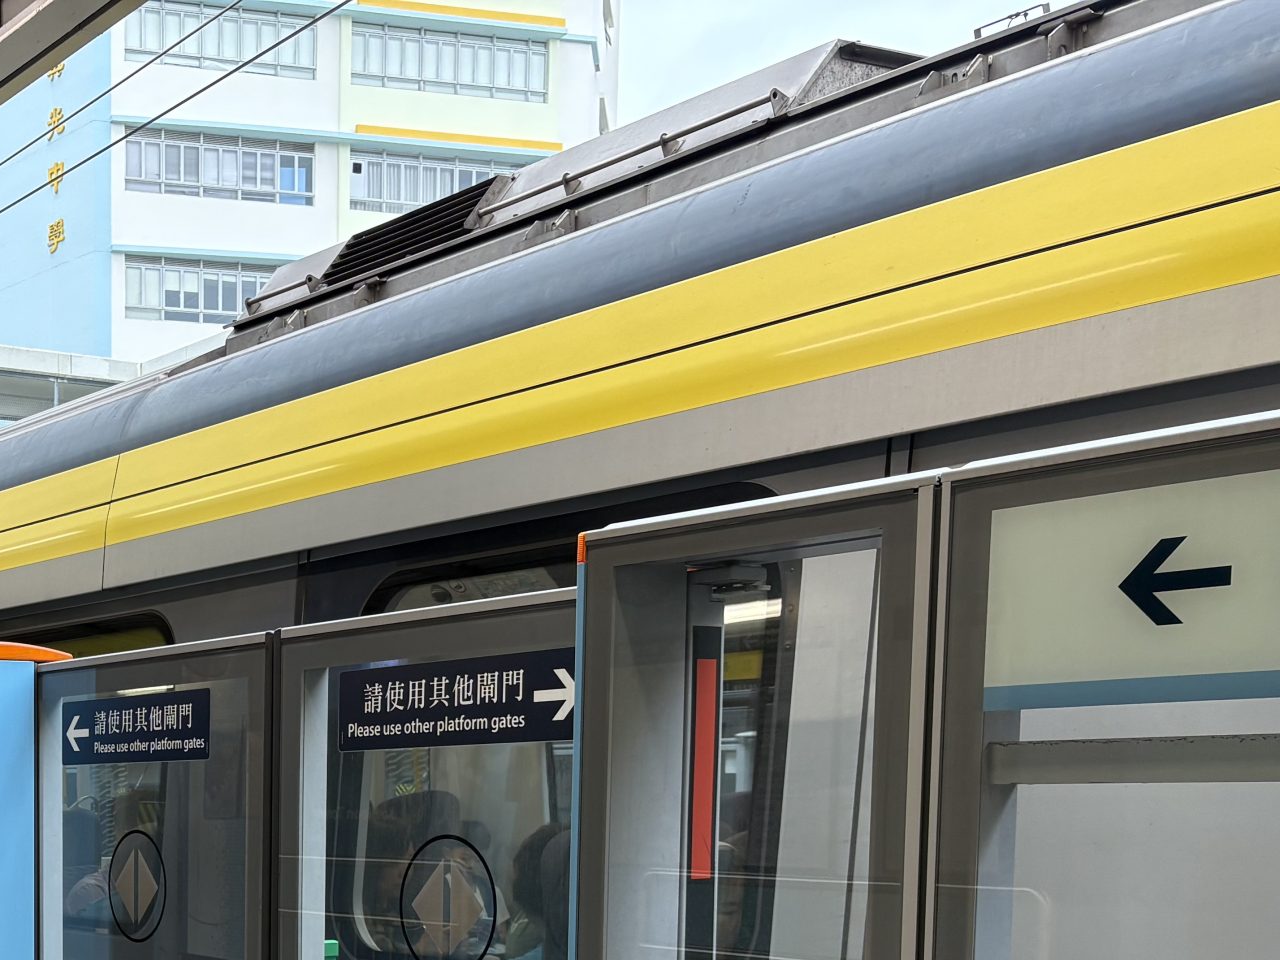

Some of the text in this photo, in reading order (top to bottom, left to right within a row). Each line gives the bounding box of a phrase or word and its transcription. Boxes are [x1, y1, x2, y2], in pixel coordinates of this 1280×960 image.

[363, 669, 525, 714] 請使用其他閘門
[94, 703, 193, 735] 請使用其他閘門
[348, 714, 525, 738] Please use other platform gates
[94, 737, 205, 754] Please use other platform gates
